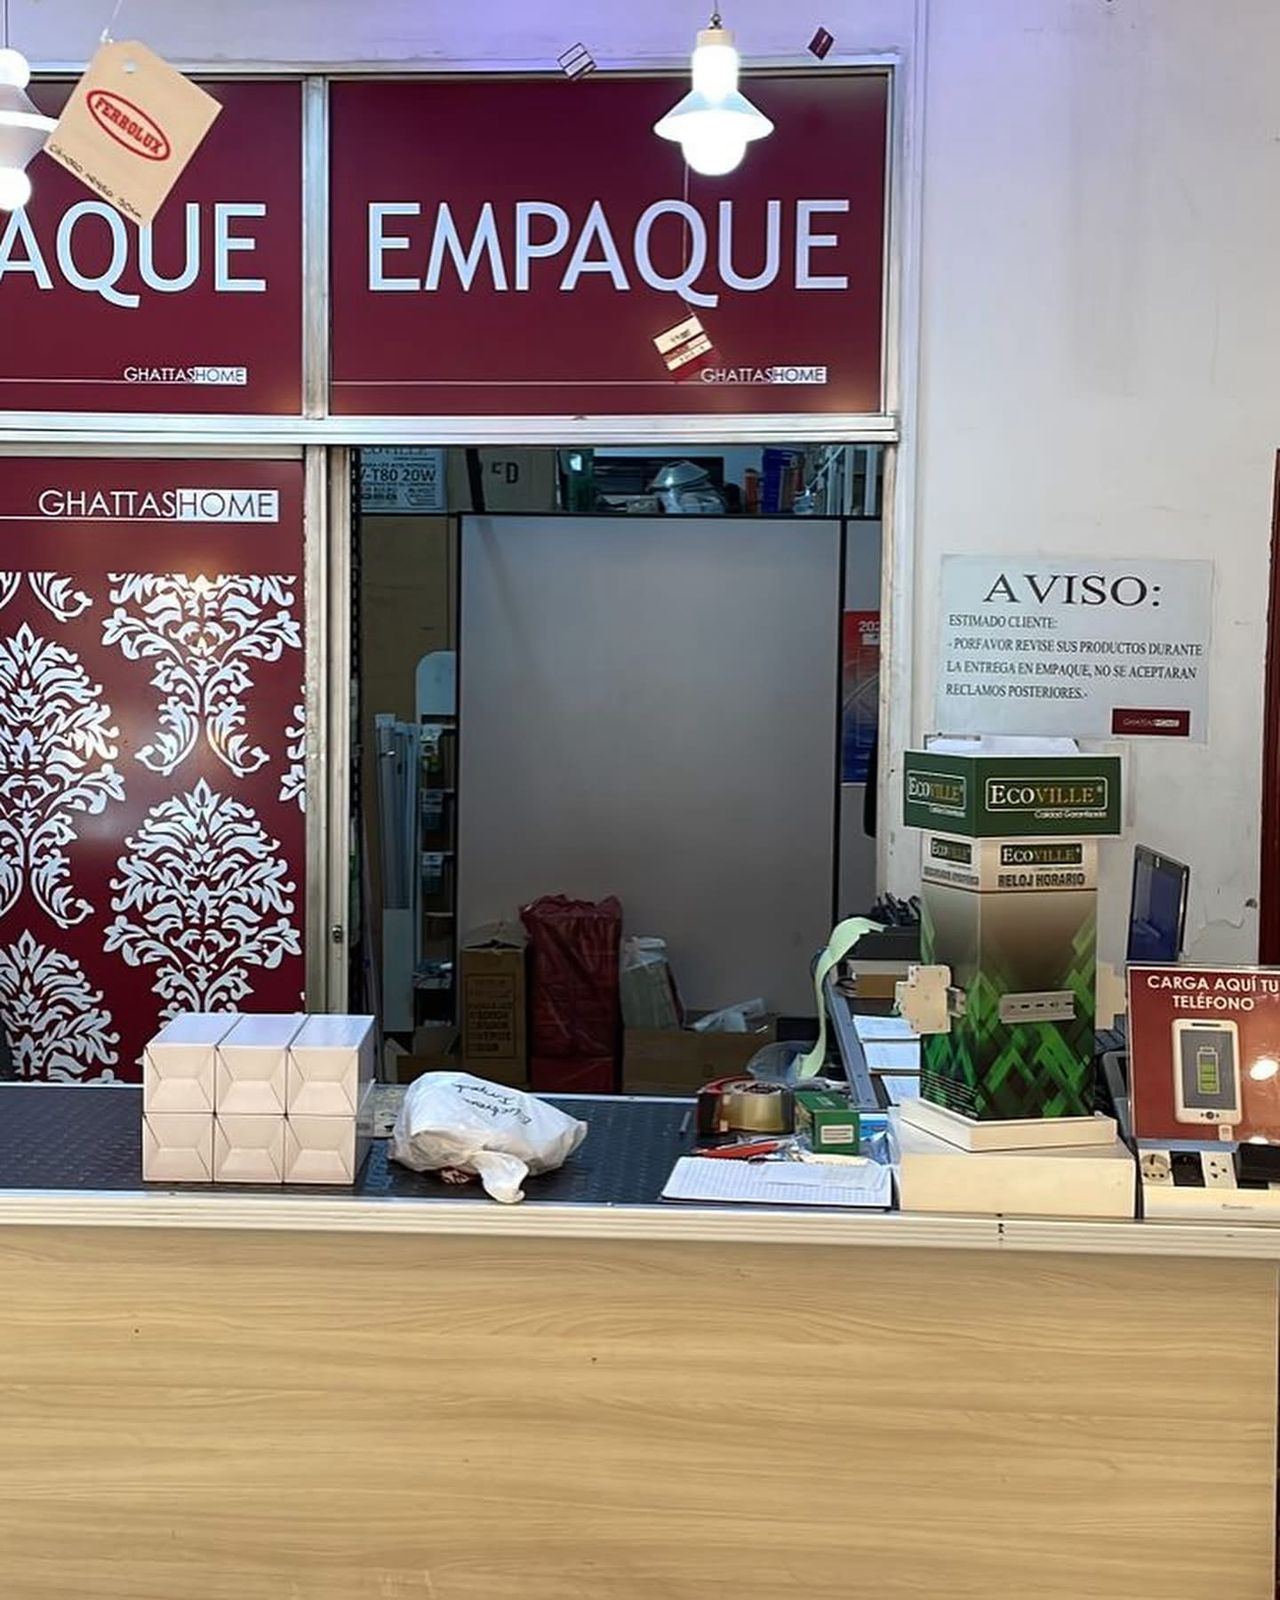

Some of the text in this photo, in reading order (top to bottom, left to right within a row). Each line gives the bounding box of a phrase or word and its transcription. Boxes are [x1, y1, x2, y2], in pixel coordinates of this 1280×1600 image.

[94, 97, 163, 154] FERROLUX
[0, 200, 267, 308] AQUE
[368, 199, 850, 308] EMPAQUE
[402, 468, 437, 482] 20W
[982, 573, 1161, 607] AVISO:
[949, 614, 1058, 629] ESTIMADO CLIENTE:
[954, 638, 1013, 652] PORFAVOR
[1014, 640, 1055, 652] REVISE
[1056, 641, 1078, 653] SUS
[1079, 641, 1146, 655] PRODUCTOS
[1148, 643, 1202, 657] DURANTE
[947, 661, 1197, 680] LA ENTREGA EN EMPAQUE, NO SE ACEPTARAN
[946, 684, 1006, 697] RECLAMOS
[998, 873, 1086, 887] RELOJ HORARIO
[1147, 975, 1279, 993] CARGA AQUÍ TU
[1172, 993, 1255, 1011] TELÉFONO
